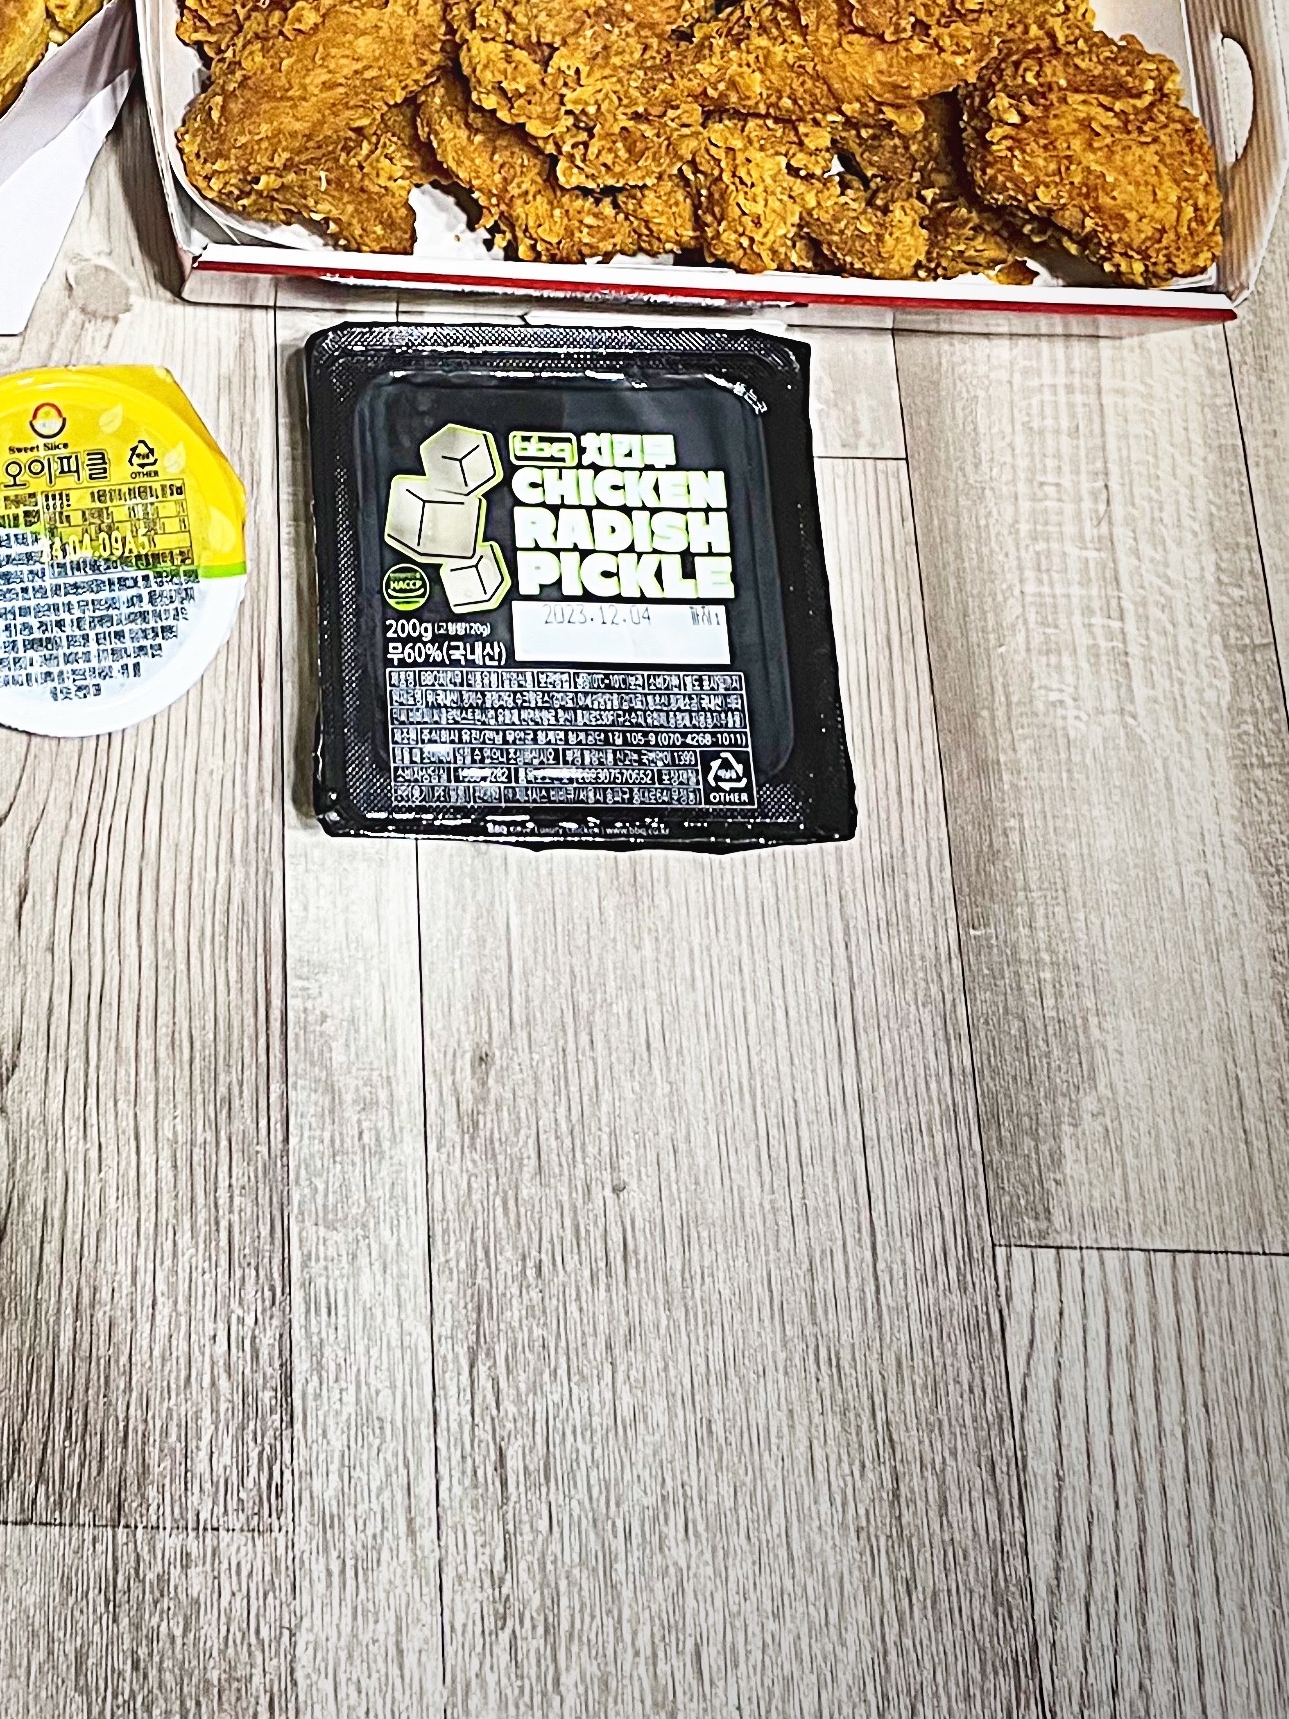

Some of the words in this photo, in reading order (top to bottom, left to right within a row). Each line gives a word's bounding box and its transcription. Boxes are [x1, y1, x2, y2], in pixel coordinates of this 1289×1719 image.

[9, 444, 39, 454] Sweet
[43, 441, 69, 452] Slice
[513, 435, 574, 463] bbq
[581, 433, 677, 468] 치킨무
[2, 450, 109, 487] 오이피클
[130, 470, 159, 479] OTHER
[512, 467, 727, 508] CHICKEN
[514, 507, 730, 553] RADISH
[390, 580, 422, 589] HACCP
[517, 551, 735, 598] PICKLE
[543, 604, 651, 625] 2023.12.04
[385, 619, 432, 641] 200g
[387, 641, 506, 665] 무60%(국내산)
[422, 729, 458, 743] 주식회사
[626, 733, 655, 745] 105-9
[658, 733, 746, 746] (070-4268-1011)
[617, 750, 638, 765] 신고는
[674, 751, 695, 764] 1399
[710, 793, 748, 803] OTHER
